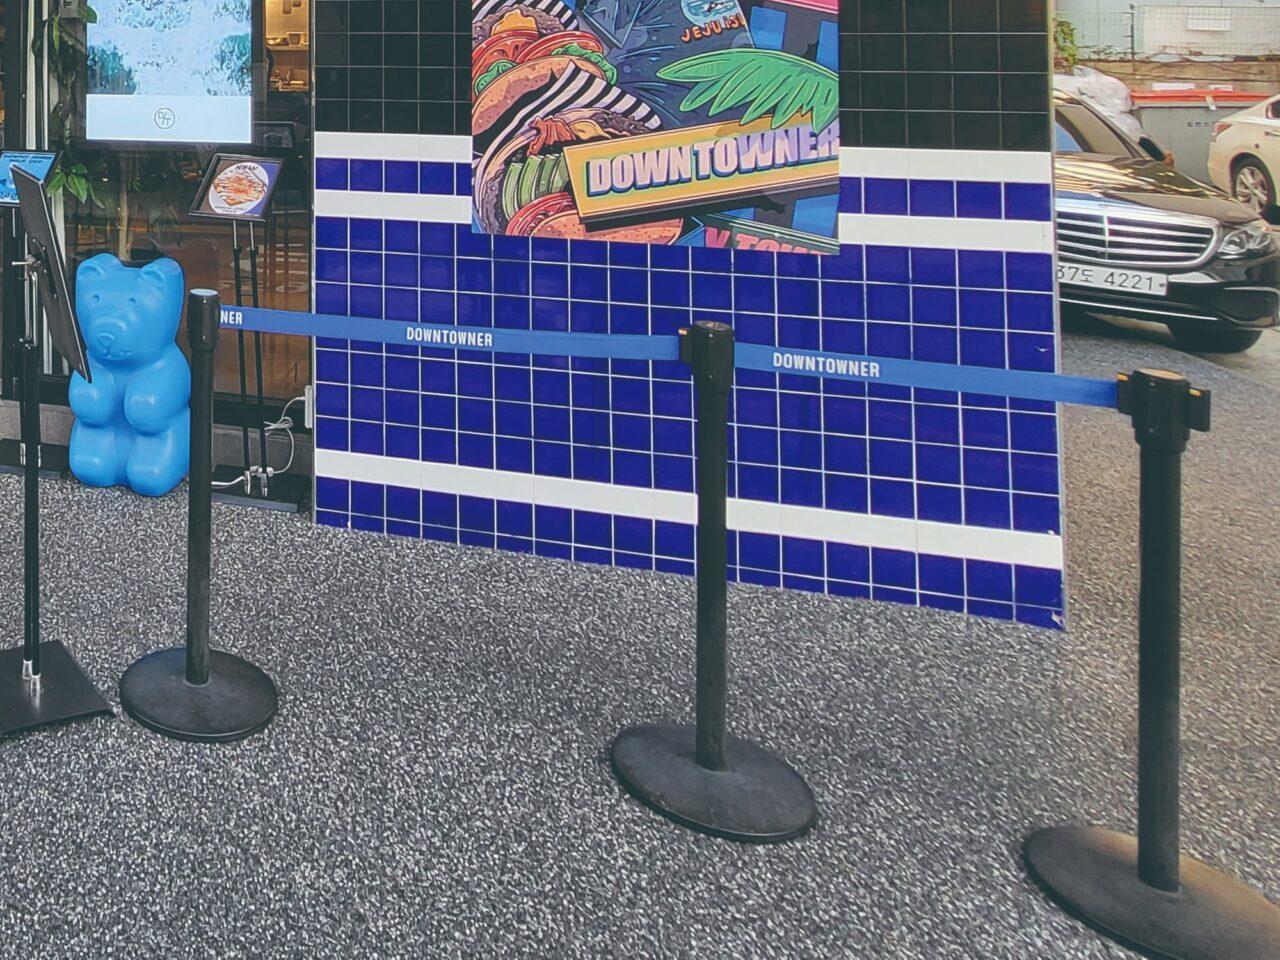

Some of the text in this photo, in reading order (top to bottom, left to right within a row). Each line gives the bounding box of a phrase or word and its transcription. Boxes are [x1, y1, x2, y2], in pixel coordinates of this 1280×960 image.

[681, 19, 722, 42] JEJU
[587, 130, 838, 193] DOWNTOWNER
[1104, 271, 1153, 291] 4221
[221, 310, 243, 325] NER
[406, 326, 493, 347] DOWNTOWNER
[773, 352, 880, 378] DOWNTOWNER
